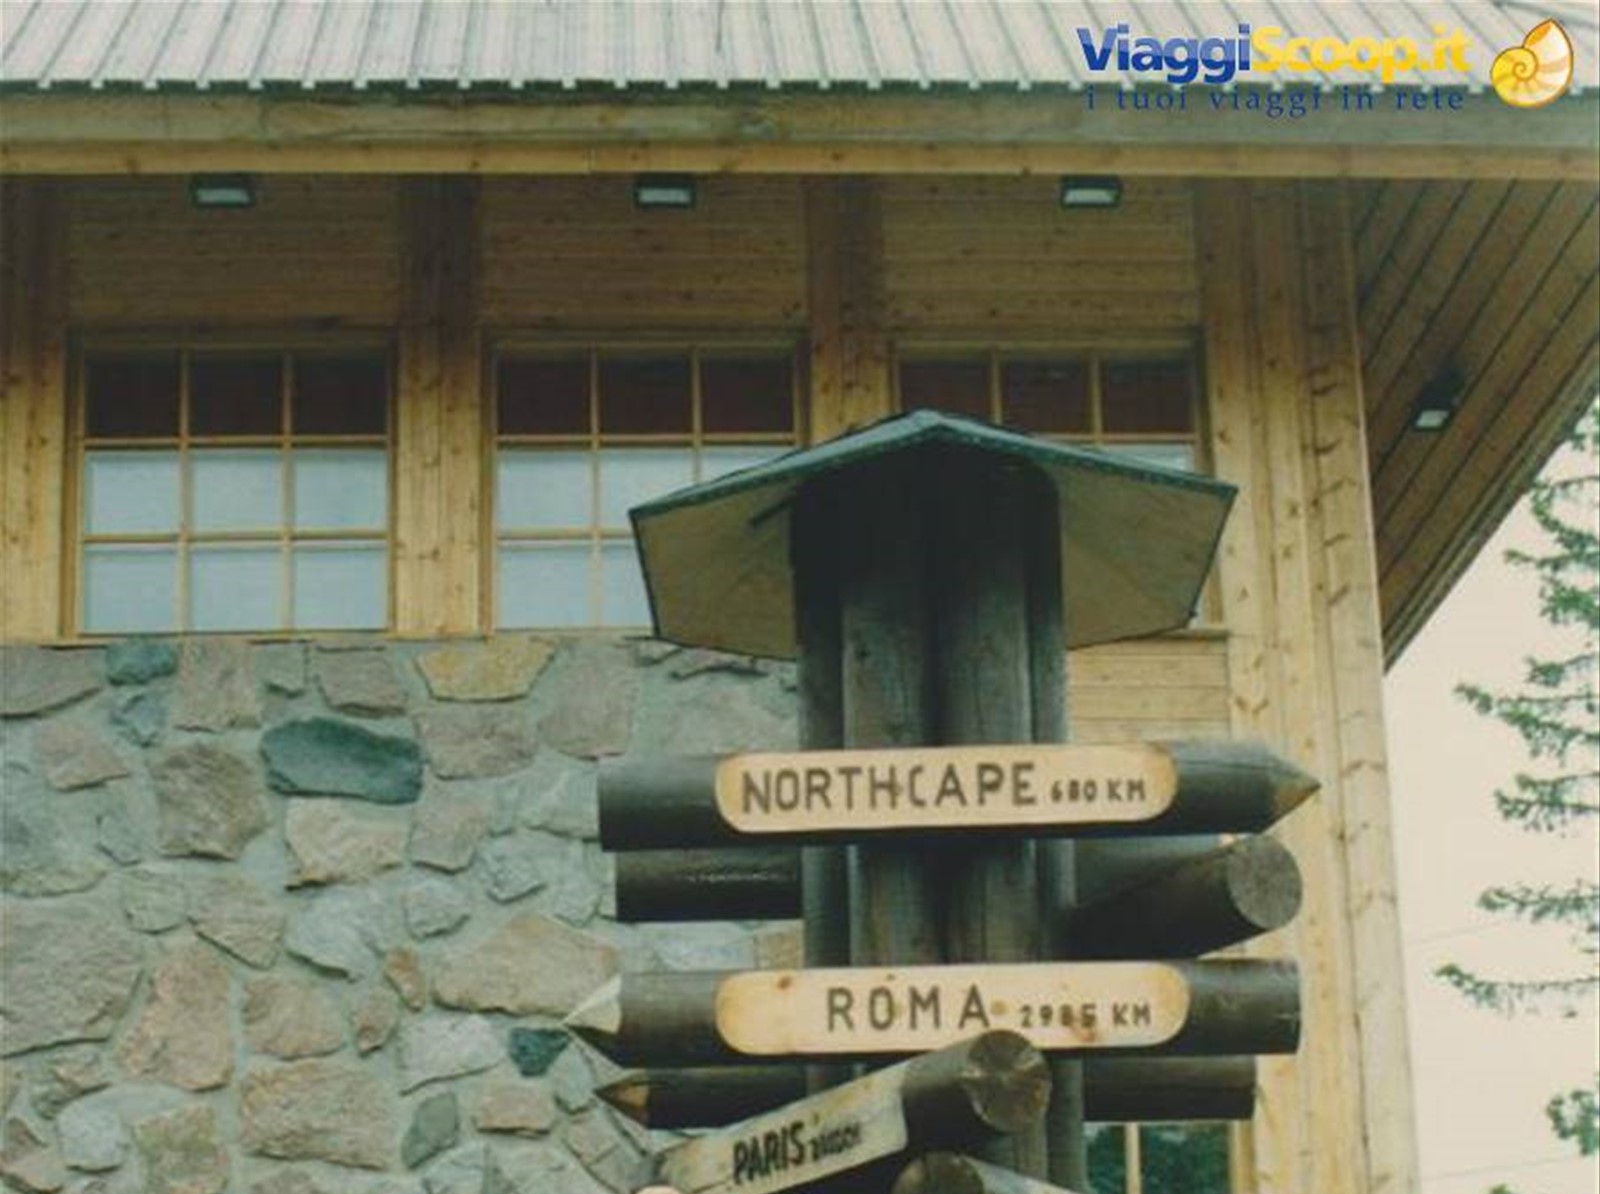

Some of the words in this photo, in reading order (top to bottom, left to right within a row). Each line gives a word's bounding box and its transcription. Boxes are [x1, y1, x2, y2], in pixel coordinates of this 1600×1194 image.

[1050, 779, 1097, 804] 680
[1107, 778, 1147, 803] KM
[827, 984, 990, 1033] ROMA
[1113, 1003, 1151, 1027] KM
[733, 1121, 805, 1185] PARIS
